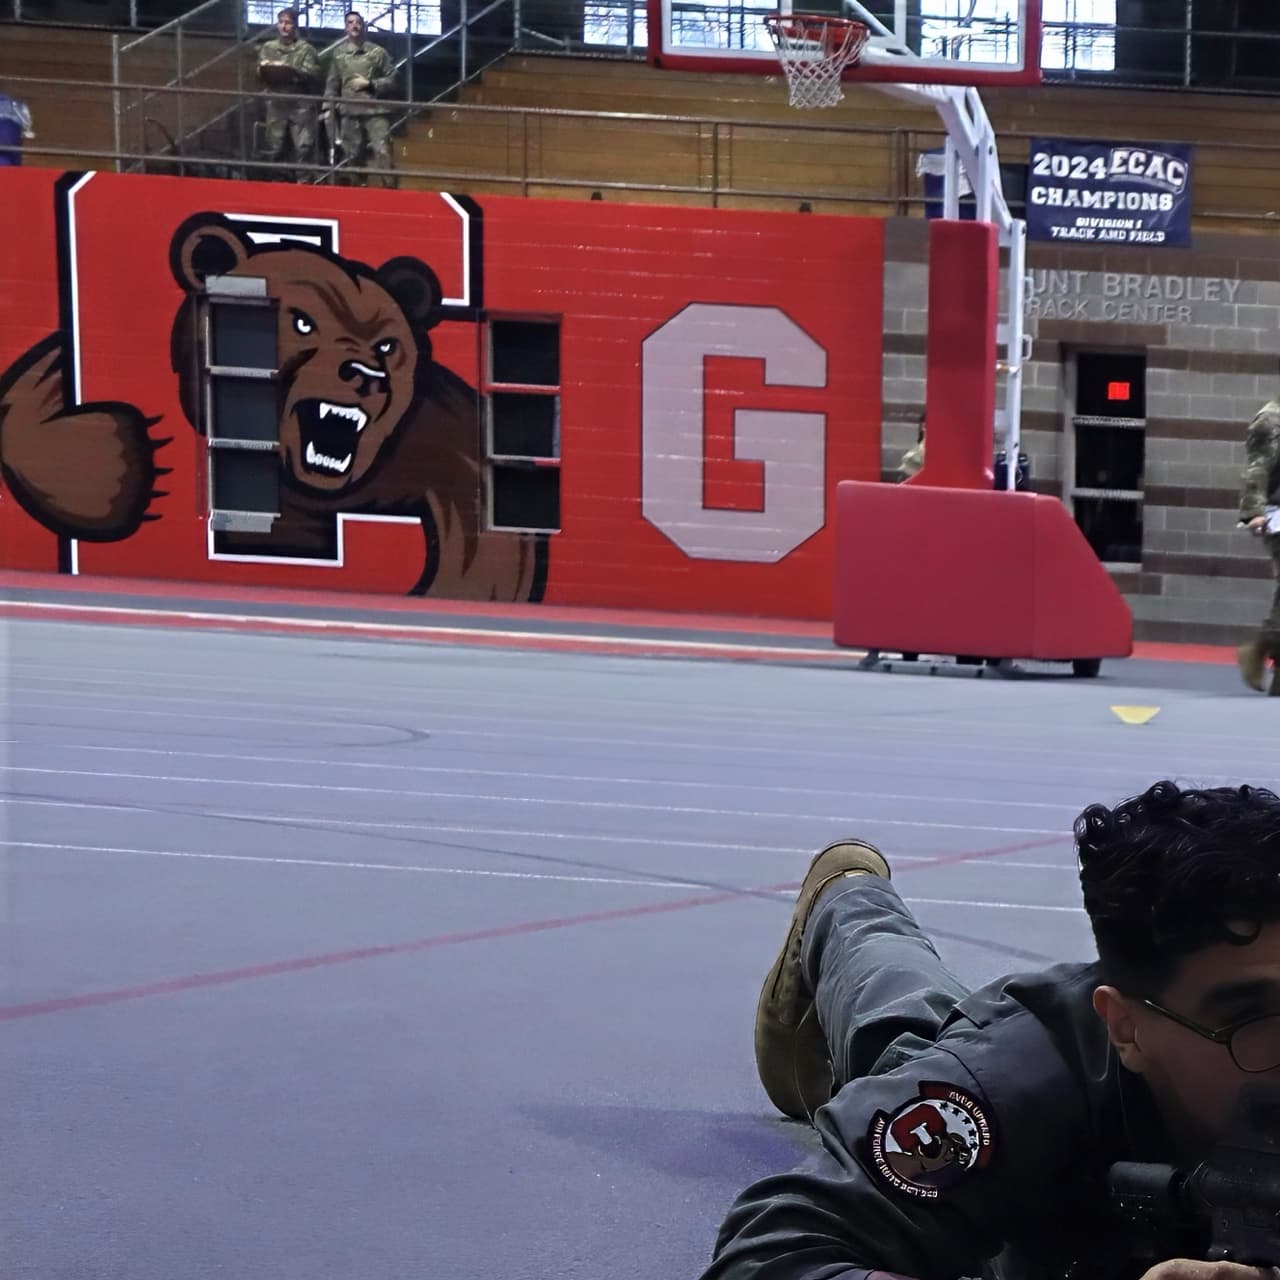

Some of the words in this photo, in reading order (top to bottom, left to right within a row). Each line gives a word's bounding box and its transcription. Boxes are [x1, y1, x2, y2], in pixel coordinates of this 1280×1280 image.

[1032, 152, 1107, 180] 2024
[1109, 150, 1186, 187] ECAC
[1031, 186, 1174, 211] CHAMPIONS
[1051, 226, 1096, 240] TRACK
[1098, 228, 1127, 240] AND
[1027, 268, 1089, 294] UNT
[1103, 272, 1241, 302] BRADLEY
[1025, 296, 1089, 319] RACK
[1103, 300, 1193, 323] CENTER
